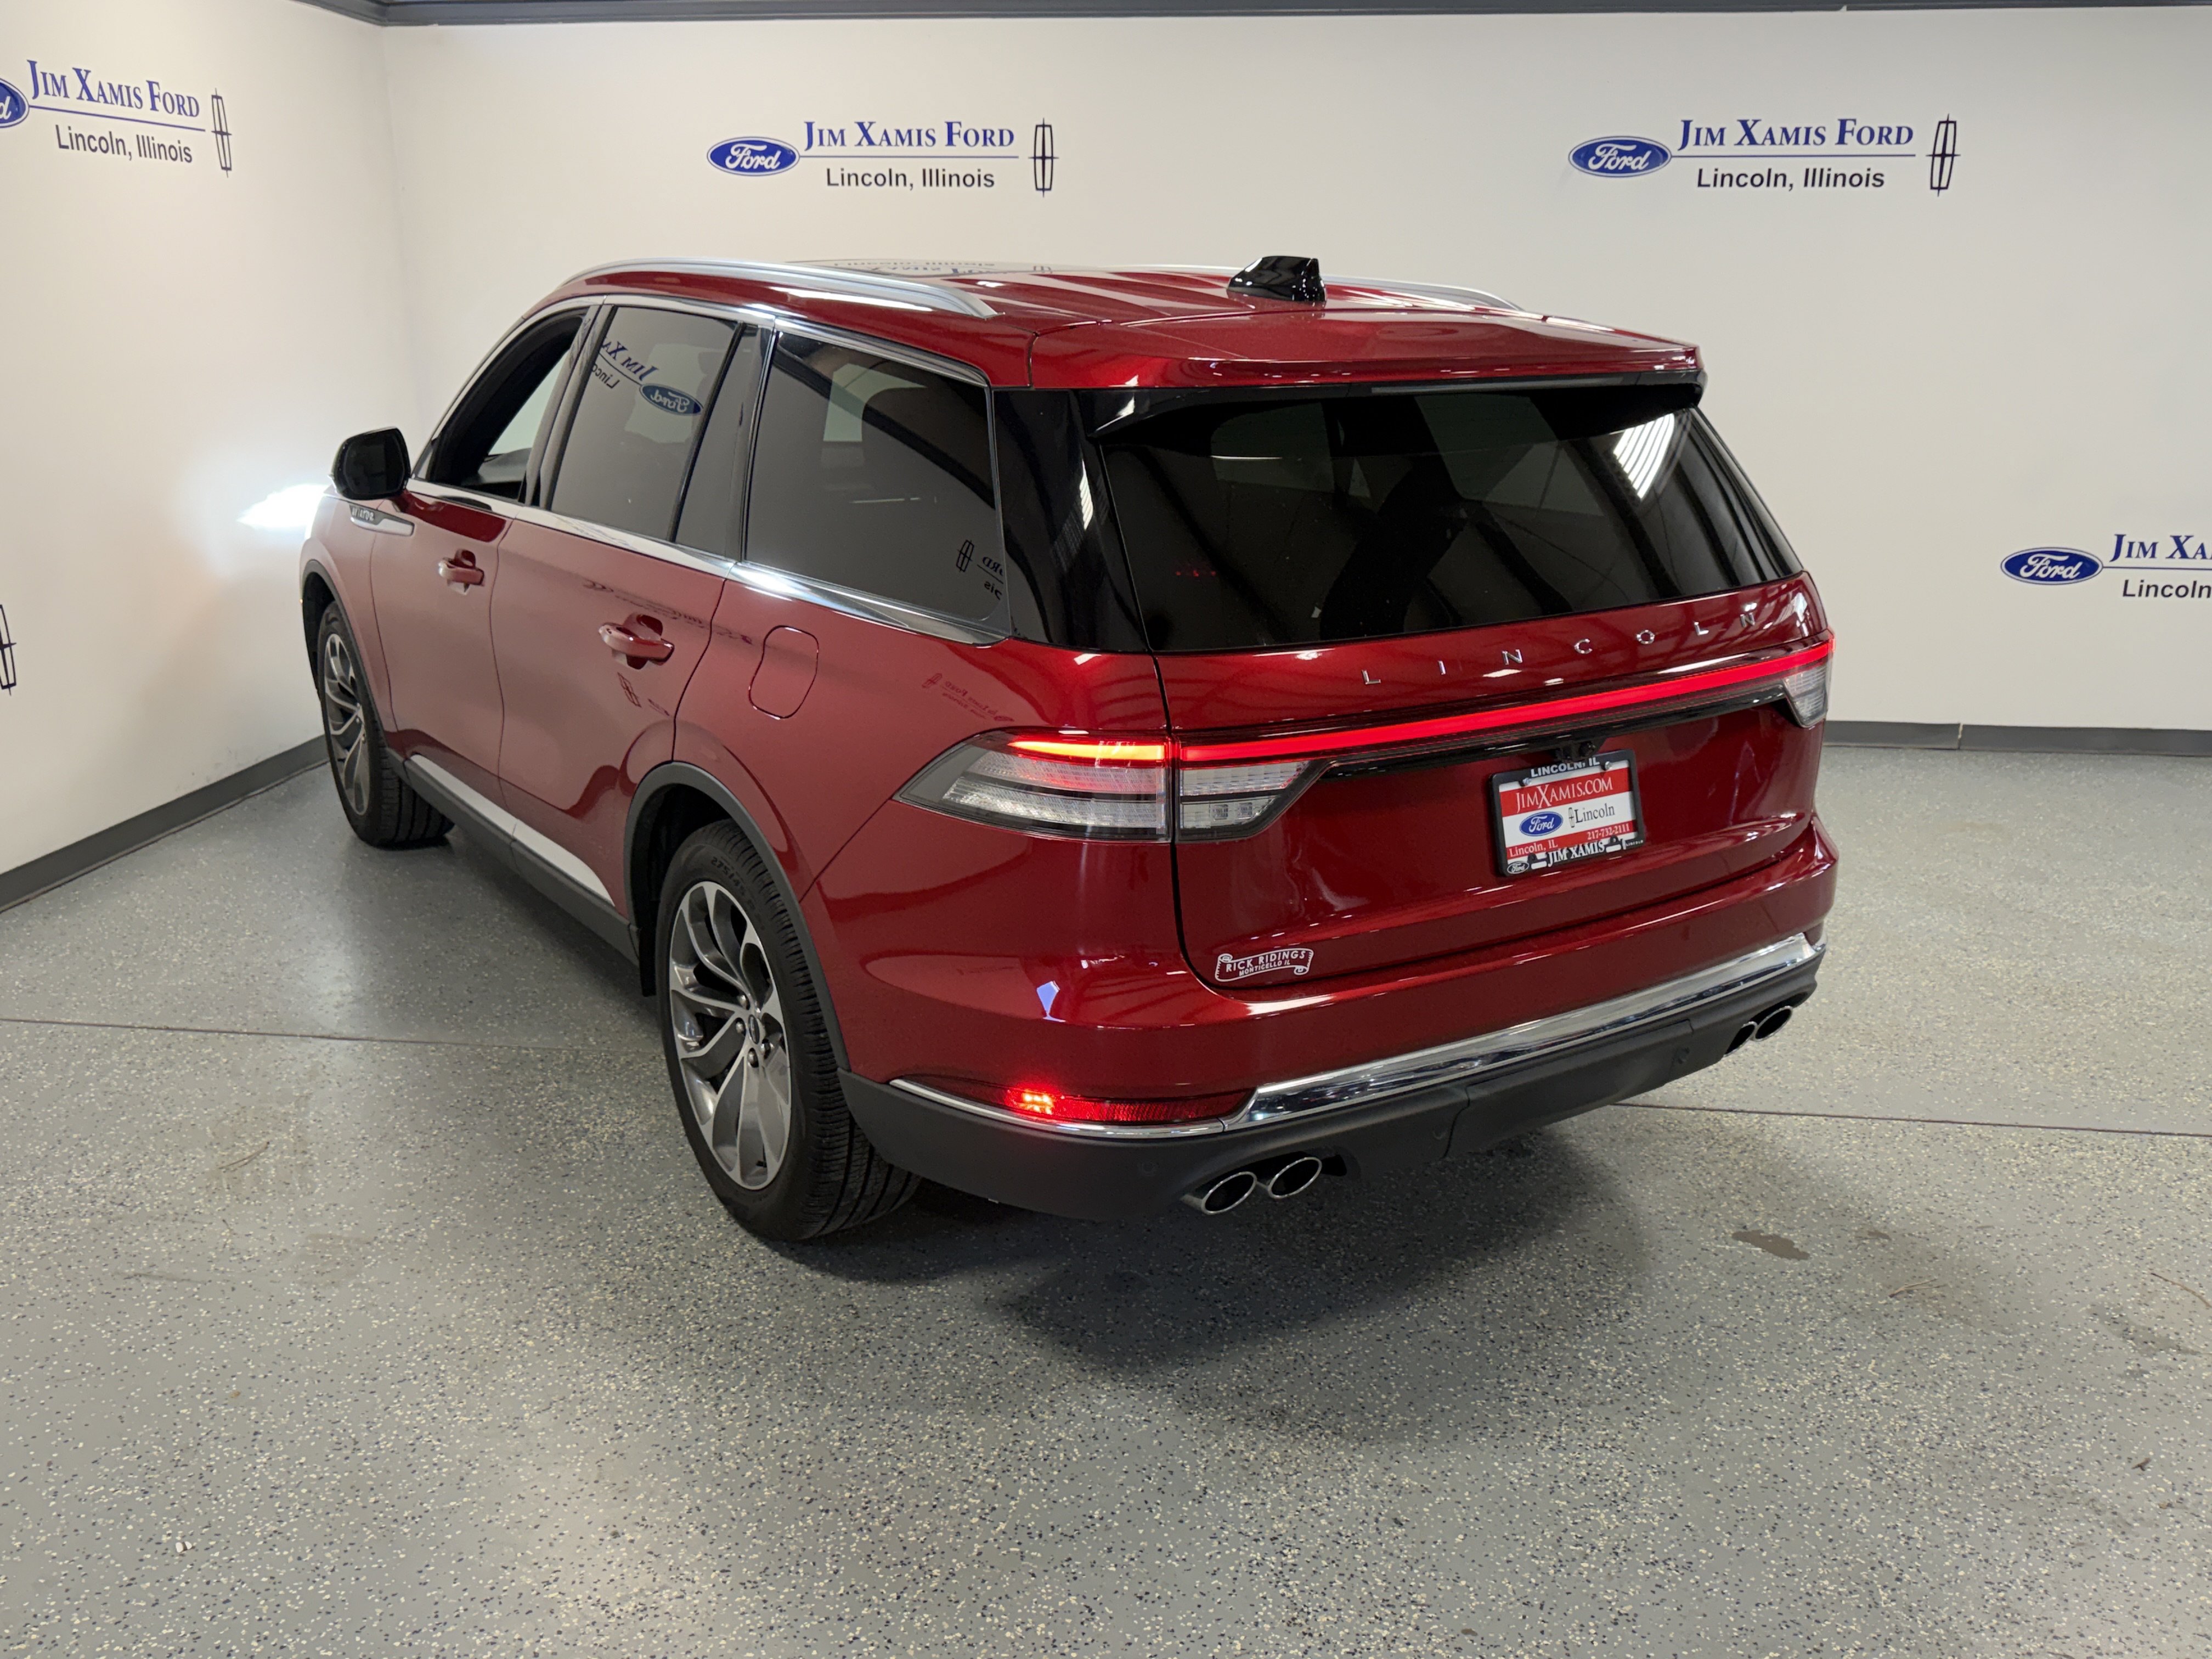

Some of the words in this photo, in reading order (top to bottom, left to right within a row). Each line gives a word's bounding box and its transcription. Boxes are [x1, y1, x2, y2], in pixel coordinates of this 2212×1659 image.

[27, 59, 70, 100] JIM
[72, 67, 143, 110] XAMIS
[146, 80, 200, 117] FORD
[55, 124, 132, 161] Lincoln,
[137, 134, 193, 163] Illinois
[804, 121, 846, 151] JIM
[854, 121, 936, 147] XAMIS
[945, 121, 1014, 146] FORD
[1678, 119, 1726, 151] JIM
[1735, 119, 1826, 146] XAMIS
[1835, 119, 1914, 145] FORD
[725, 143, 781, 170] Ford
[1588, 142, 1651, 171] Ford
[827, 168, 913, 189] Lincoln,
[922, 168, 995, 188] Illinois
[1697, 168, 1793, 191] Lincoln,
[1804, 167, 1884, 188] Illinois
[2109, 534, 2159, 562] JIM
[2165, 535, 2212, 560] XA
[2019, 553, 2083, 579] Ford
[1361, 612, 1756, 685] LINCOLN
[1531, 761, 1585, 777] LINCOLN,
[1589, 757, 1600, 766] IL
[1516, 777, 1613, 813] JIMXAMIS.COM
[1528, 815, 1554, 832] Ford
[1574, 803, 1615, 823] Lincoln
[1587, 823, 1630, 840] 217-732-2111
[1509, 842, 1545, 857] Lincoln,
[1548, 840, 1558, 849] IL
[1548, 849, 1568, 867] JIM
[1570, 842, 1606, 859] XAMIS
[1226, 959, 1252, 973] RICK
[1259, 950, 1306, 964] RIDINGS
[1239, 961, 1282, 977] MONTICELLO
